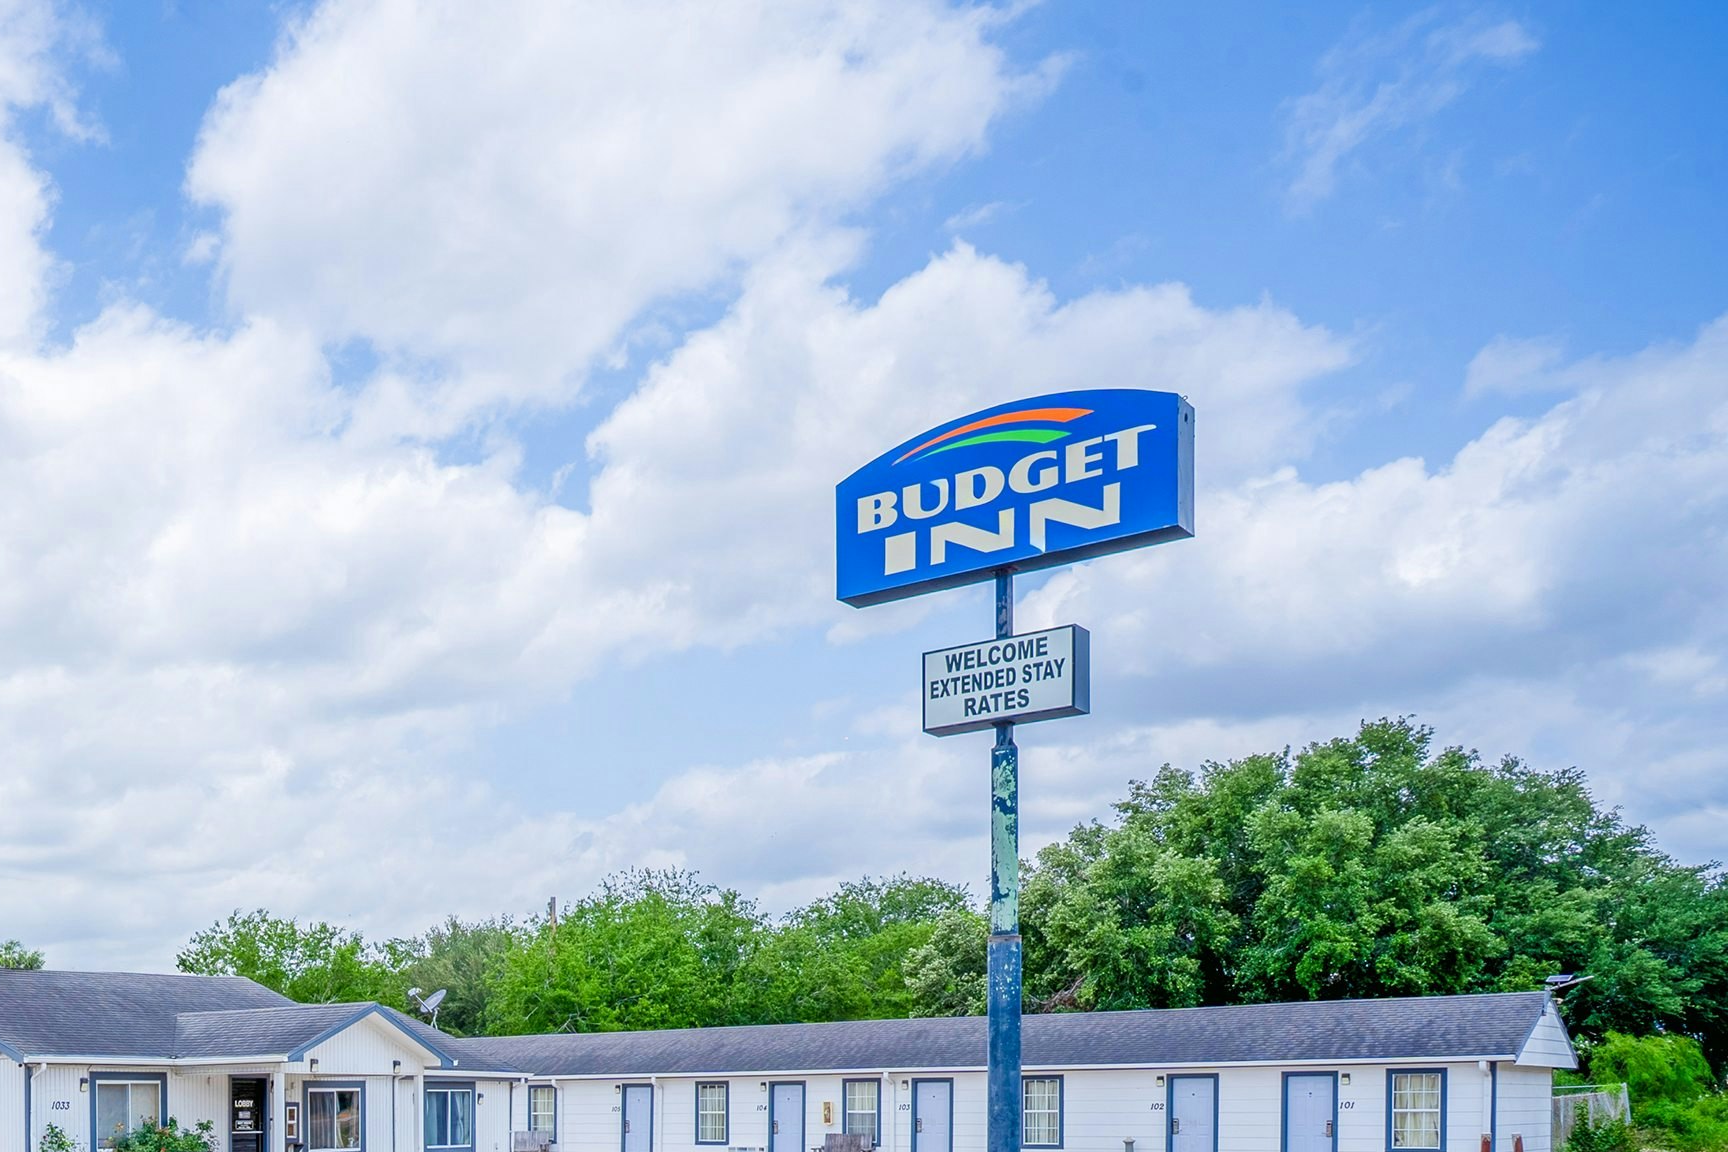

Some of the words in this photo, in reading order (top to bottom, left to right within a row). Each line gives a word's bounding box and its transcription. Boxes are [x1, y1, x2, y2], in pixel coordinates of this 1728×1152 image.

[857, 424, 1157, 534] BUDGET
[884, 481, 1121, 576] INN
[945, 636, 1048, 673] WELCOME
[930, 667, 1017, 699] EXTENDED
[1022, 658, 1065, 683] STAY
[964, 688, 1030, 717] RATES
[51, 1100, 70, 1110] 1033
[234, 1099, 254, 1108] LOBBY
[898, 1103, 911, 1111] 103
[1150, 1102, 1165, 1111] 102
[1339, 1101, 1355, 1109] 101
